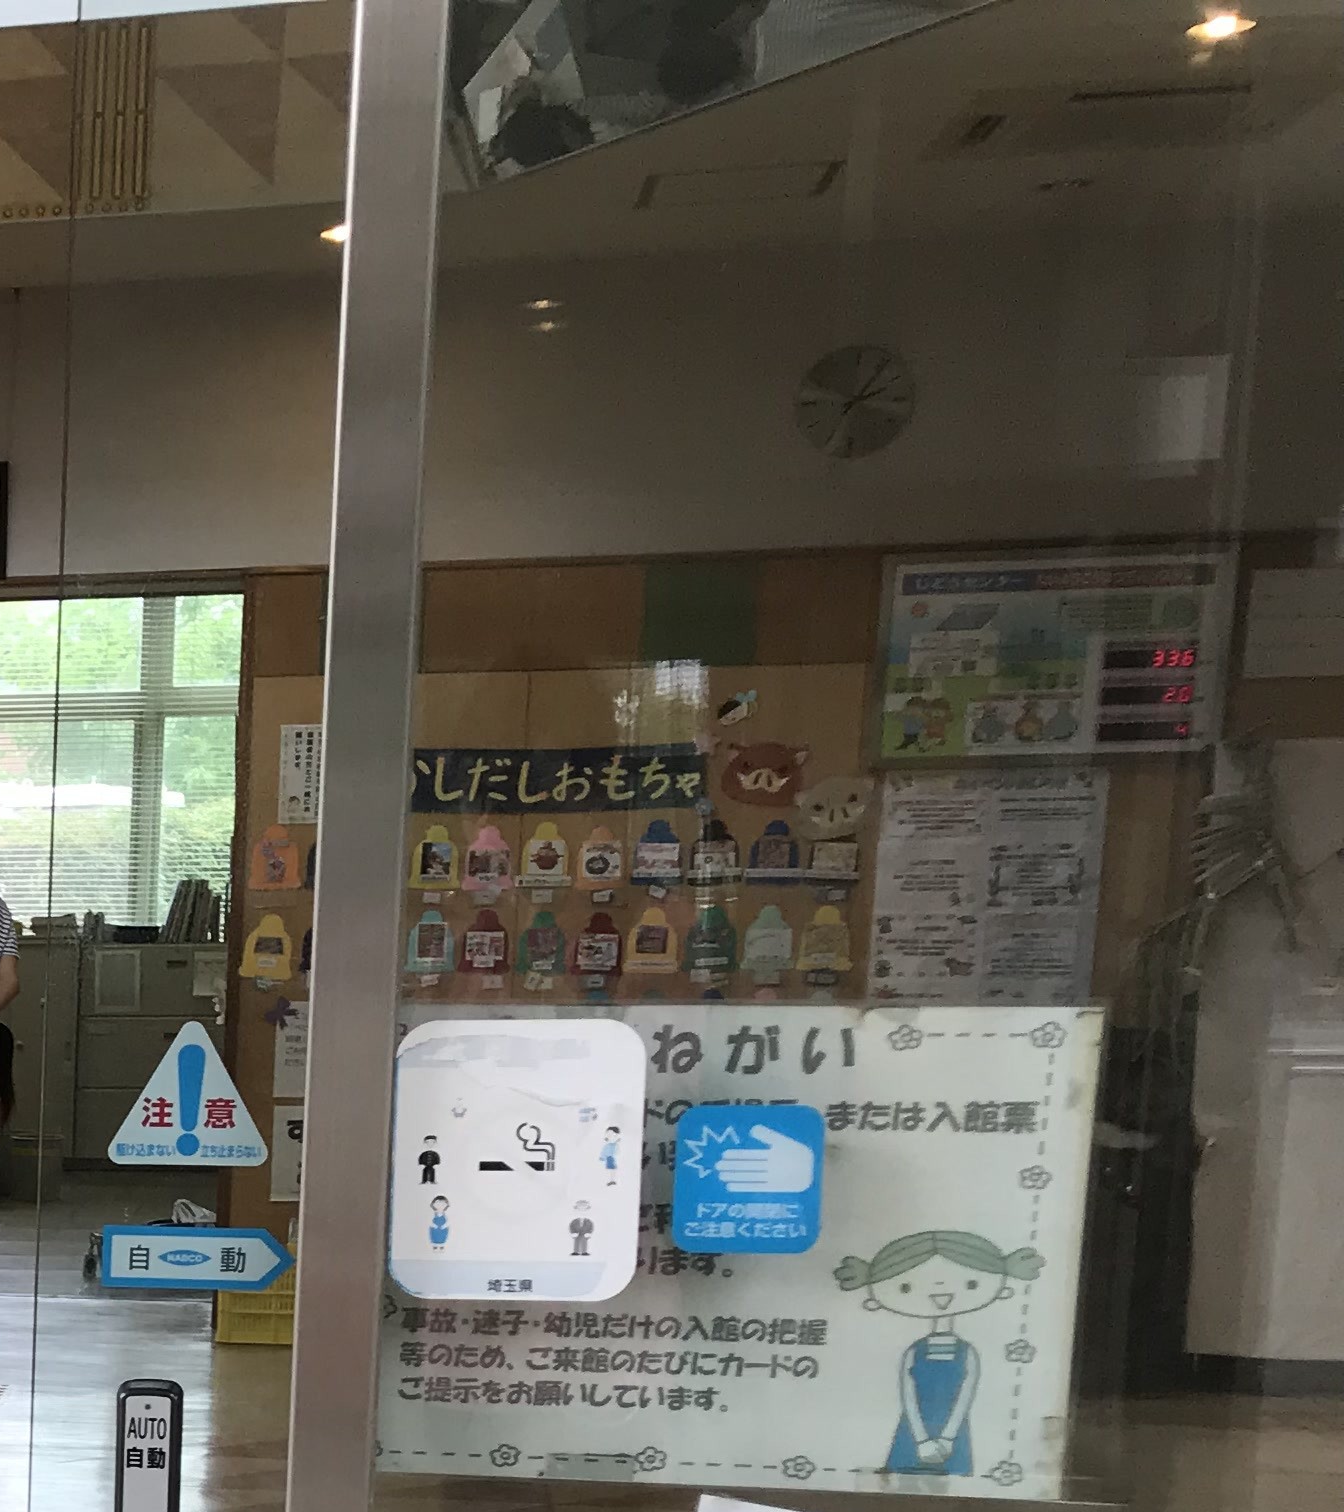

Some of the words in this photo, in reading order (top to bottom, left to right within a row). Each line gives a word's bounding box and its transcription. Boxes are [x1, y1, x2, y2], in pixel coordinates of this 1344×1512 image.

[683, 1222, 808, 1239] ご注意ください
[486, 1278, 534, 1293] 埼玉県
[399, 1341, 821, 1380] 等のため、ご来館のたびにカードの
[397, 1377, 730, 1414] ご提示をお願いしています。
[126, 1417, 167, 1440] AUTO
[126, 1446, 167, 1470] 自動
